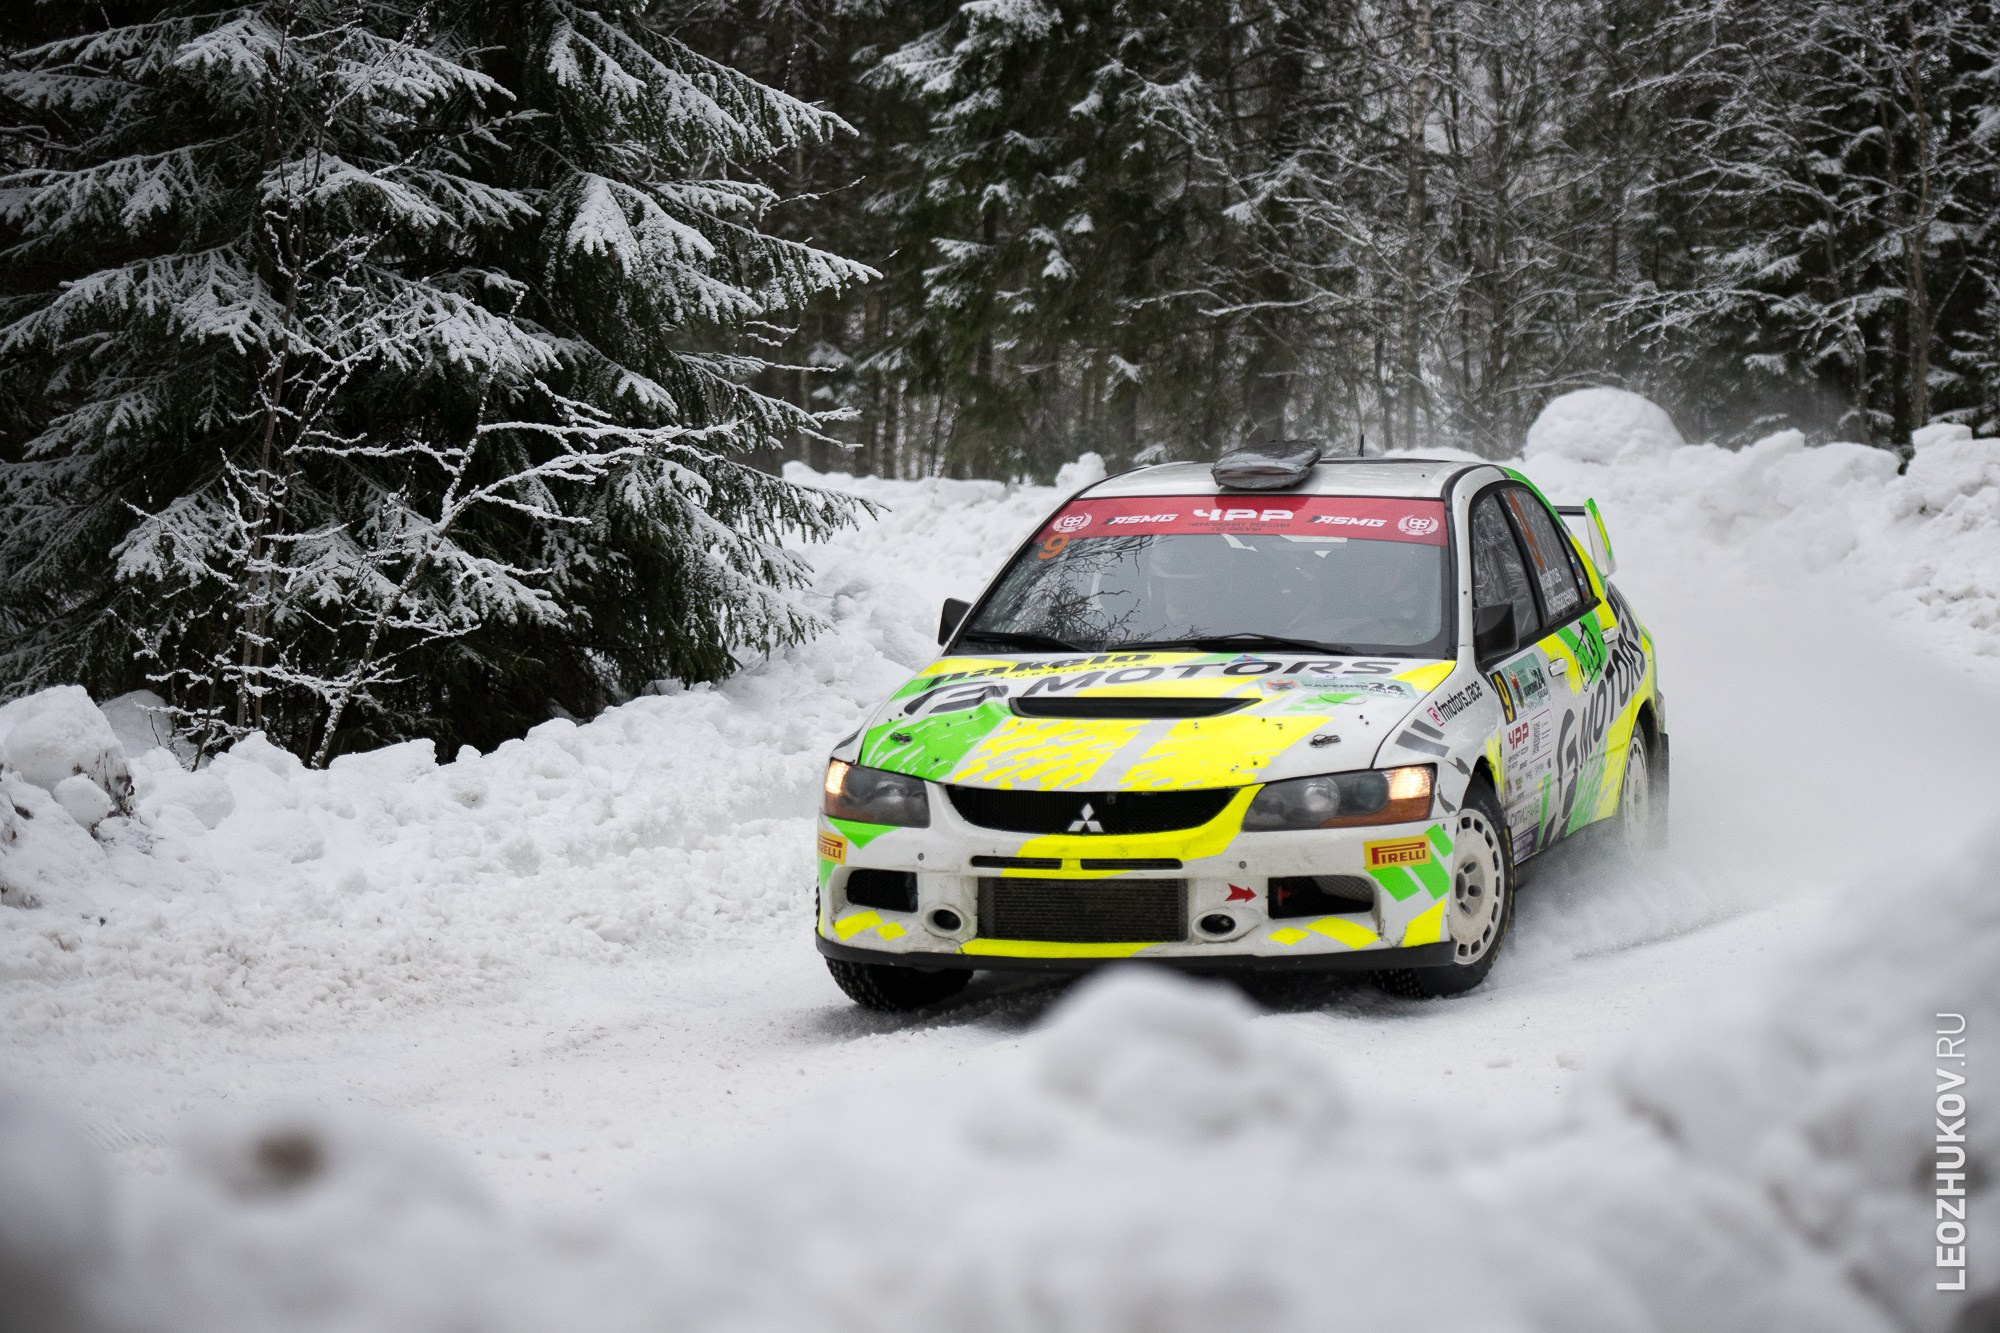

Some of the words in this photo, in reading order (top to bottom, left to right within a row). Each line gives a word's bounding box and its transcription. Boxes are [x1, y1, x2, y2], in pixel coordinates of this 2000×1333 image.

[1108, 513, 1179, 526] ASMG
[1315, 515, 1388, 528] ASMG
[1038, 533, 1070, 560] 9
[1494, 673, 1513, 722] 9
[1371, 841, 1426, 865] PIRELLI
